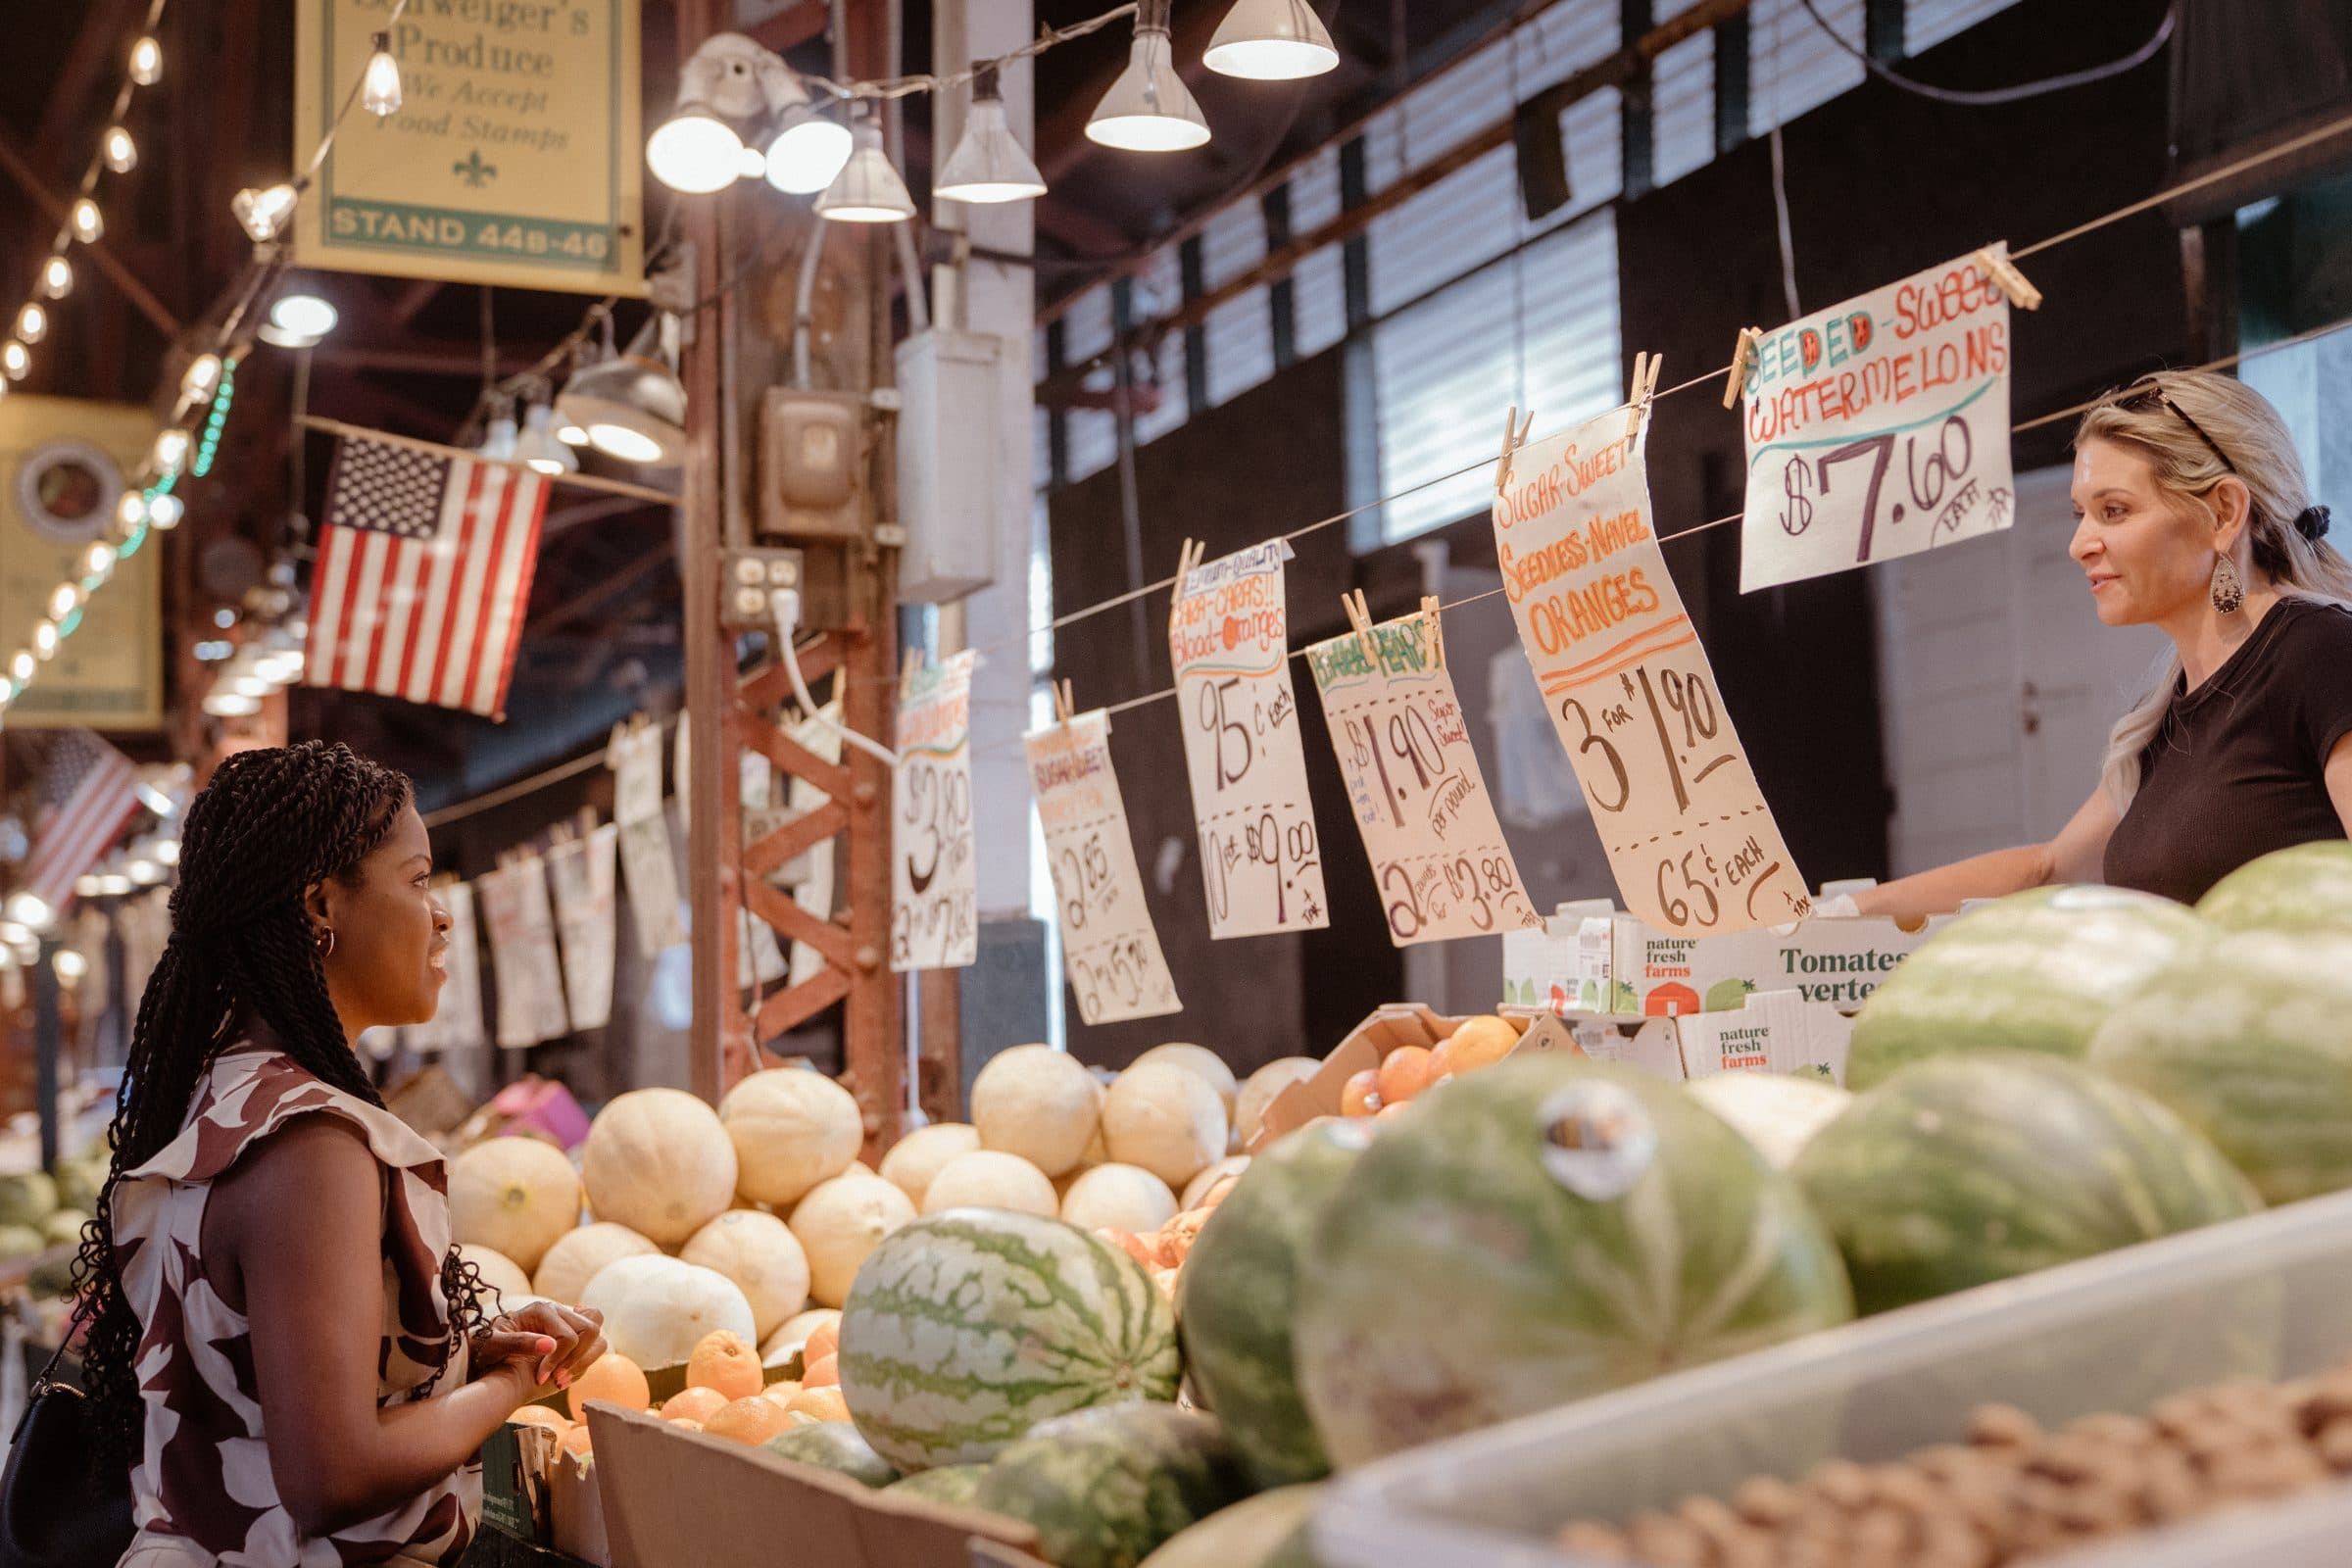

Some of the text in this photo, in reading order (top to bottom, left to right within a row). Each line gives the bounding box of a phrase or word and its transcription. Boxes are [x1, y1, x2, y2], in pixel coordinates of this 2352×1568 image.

[349, 0, 590, 35] weiger's
[397, 24, 554, 77] Produce
[451, 80, 549, 114] Accept
[462, 115, 570, 151] Stamps
[332, 207, 465, 246] STAND
[1749, 320, 2007, 443] WATERMELONS
[1498, 442, 1627, 530] SUGAR-SWEET
[1780, 415, 1972, 563] $7.60
[1529, 564, 1659, 656] ORANGES
[1345, 705, 1446, 828] $1.90
[1562, 698, 1630, 812] 3
[1601, 703, 1634, 734] FOR
[1725, 835, 1765, 886] EACH
[1383, 862, 1428, 938] 2
[1646, 938, 1696, 950] nature
[1646, 950, 1686, 963] fresh
[1645, 964, 1690, 978] farms
[1797, 977, 1881, 1003] verte
[1720, 1028, 1770, 1042] nature
[1721, 1040, 1761, 1054] fresh
[1722, 1054, 1767, 1070] farms
